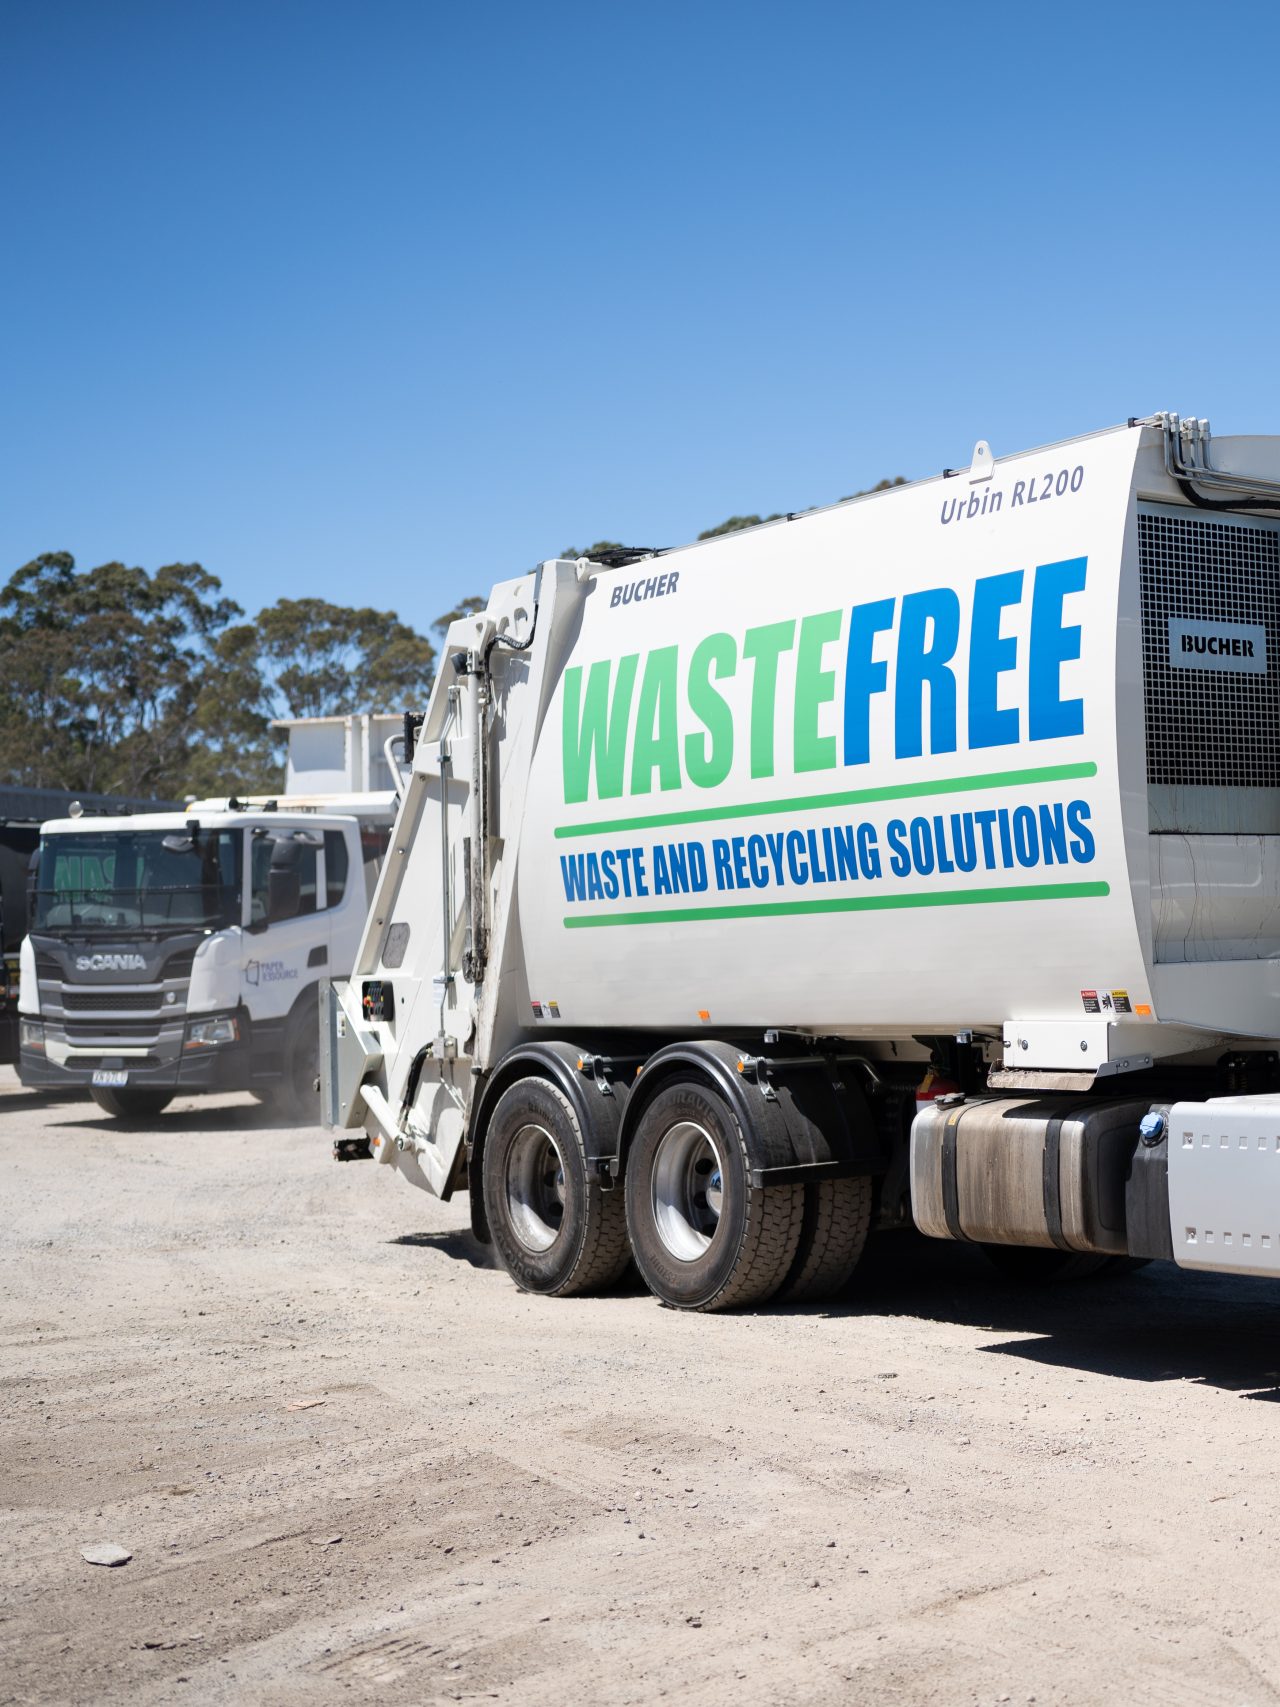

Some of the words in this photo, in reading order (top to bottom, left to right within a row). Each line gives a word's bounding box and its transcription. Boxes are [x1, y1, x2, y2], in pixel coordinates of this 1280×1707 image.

[940, 488, 1003, 525] Urbin
[1011, 465, 1085, 508] RL200
[610, 571, 680, 609] BUCHER
[1181, 634, 1254, 657] BUCHER
[562, 555, 1089, 805] WASTEFREE
[560, 844, 650, 903] WASTE
[653, 835, 708, 897] AND
[713, 823, 882, 891] RECYCLING
[887, 800, 1096, 878] SOLUTIONS
[76, 954, 147, 971] SCANIA
